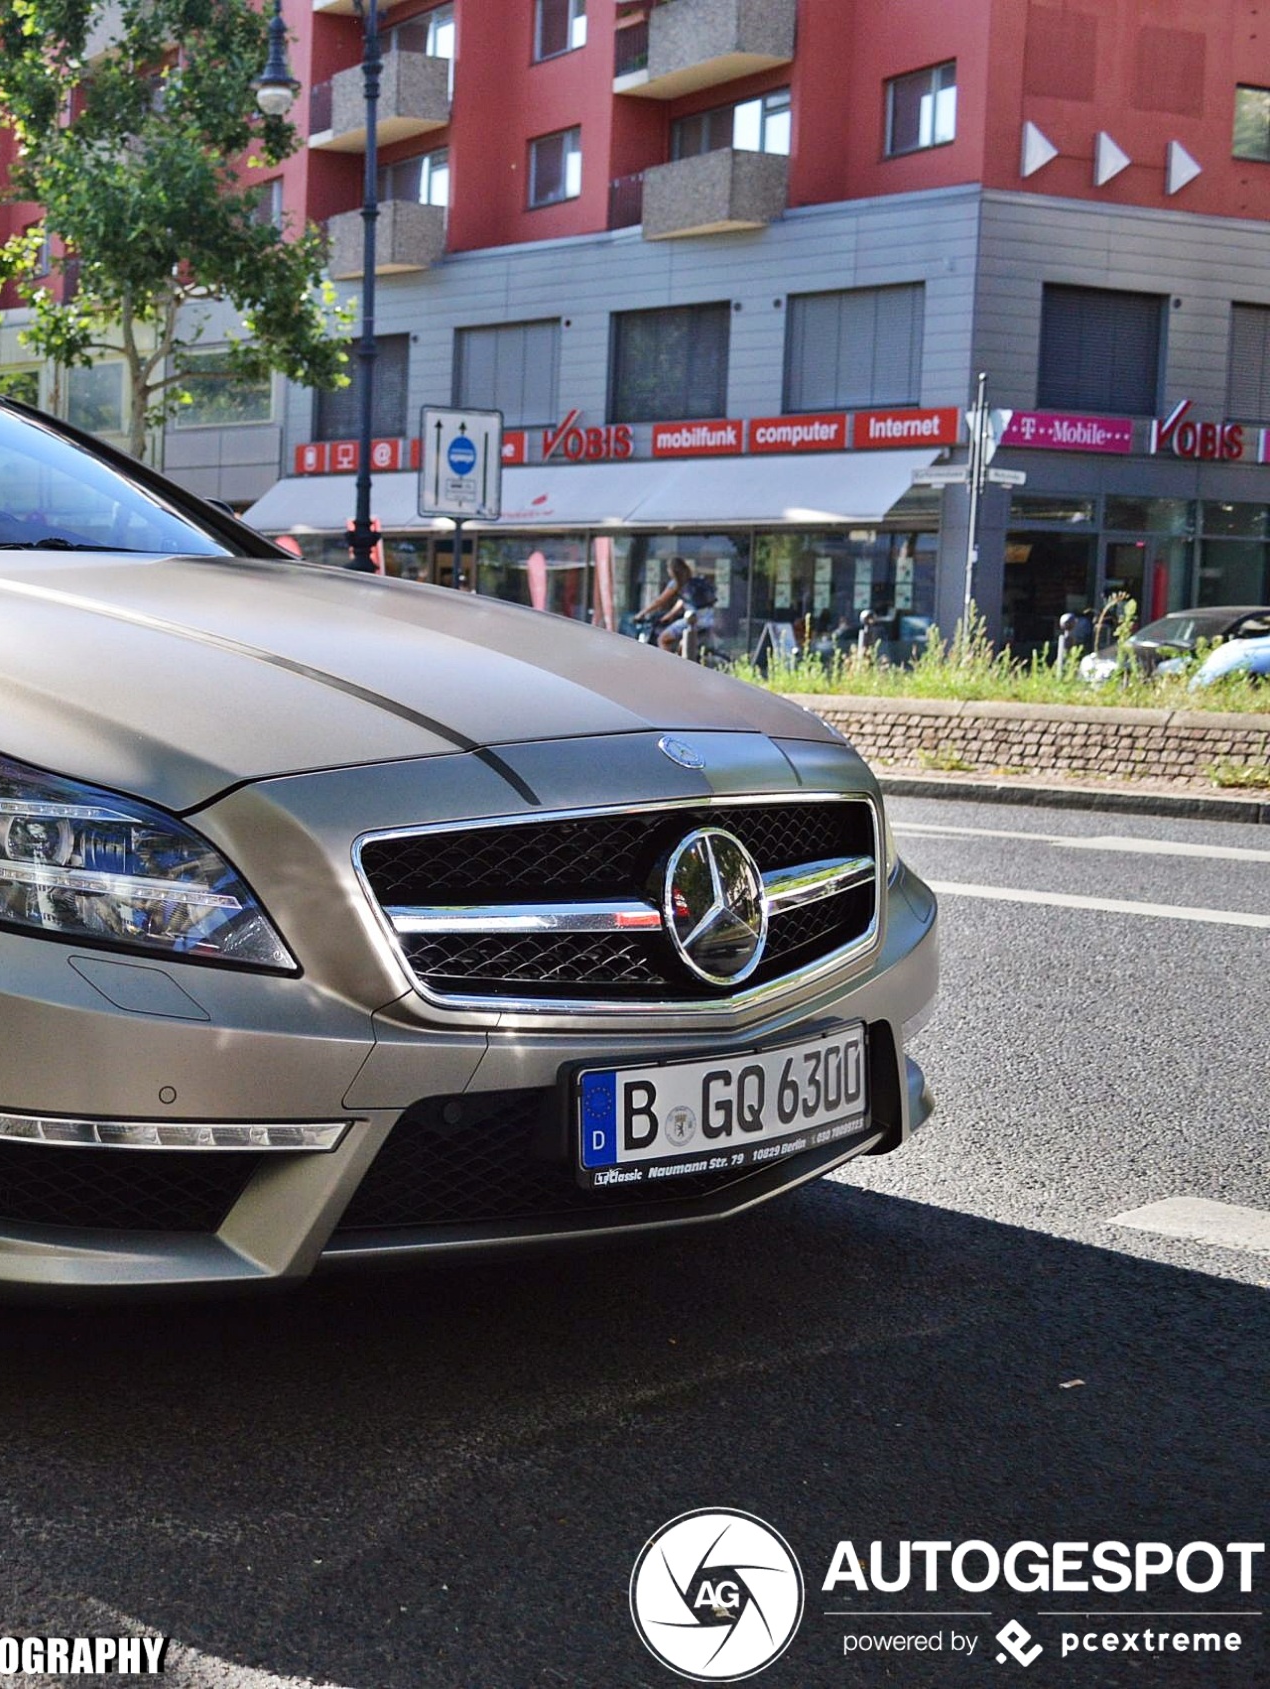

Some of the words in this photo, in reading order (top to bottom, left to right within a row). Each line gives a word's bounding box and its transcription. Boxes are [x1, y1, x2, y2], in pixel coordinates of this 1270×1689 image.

[543, 408, 633, 462] VOBIS
[657, 426, 737, 449] mobilfunk
[755, 422, 839, 446] computer
[868, 415, 941, 439] Internet
[1150, 399, 1244, 460] VOBIS
[623, 1080, 659, 1150] B
[701, 1064, 766, 1140] GQ
[777, 1038, 861, 1125] 6300
[592, 1130, 605, 1150] D
[648, 1161, 708, 1178] Naumann
[708, 1157, 729, 1170] Str.
[730, 1153, 744, 1166] 79
[780, 1138, 808, 1154] Berlin
